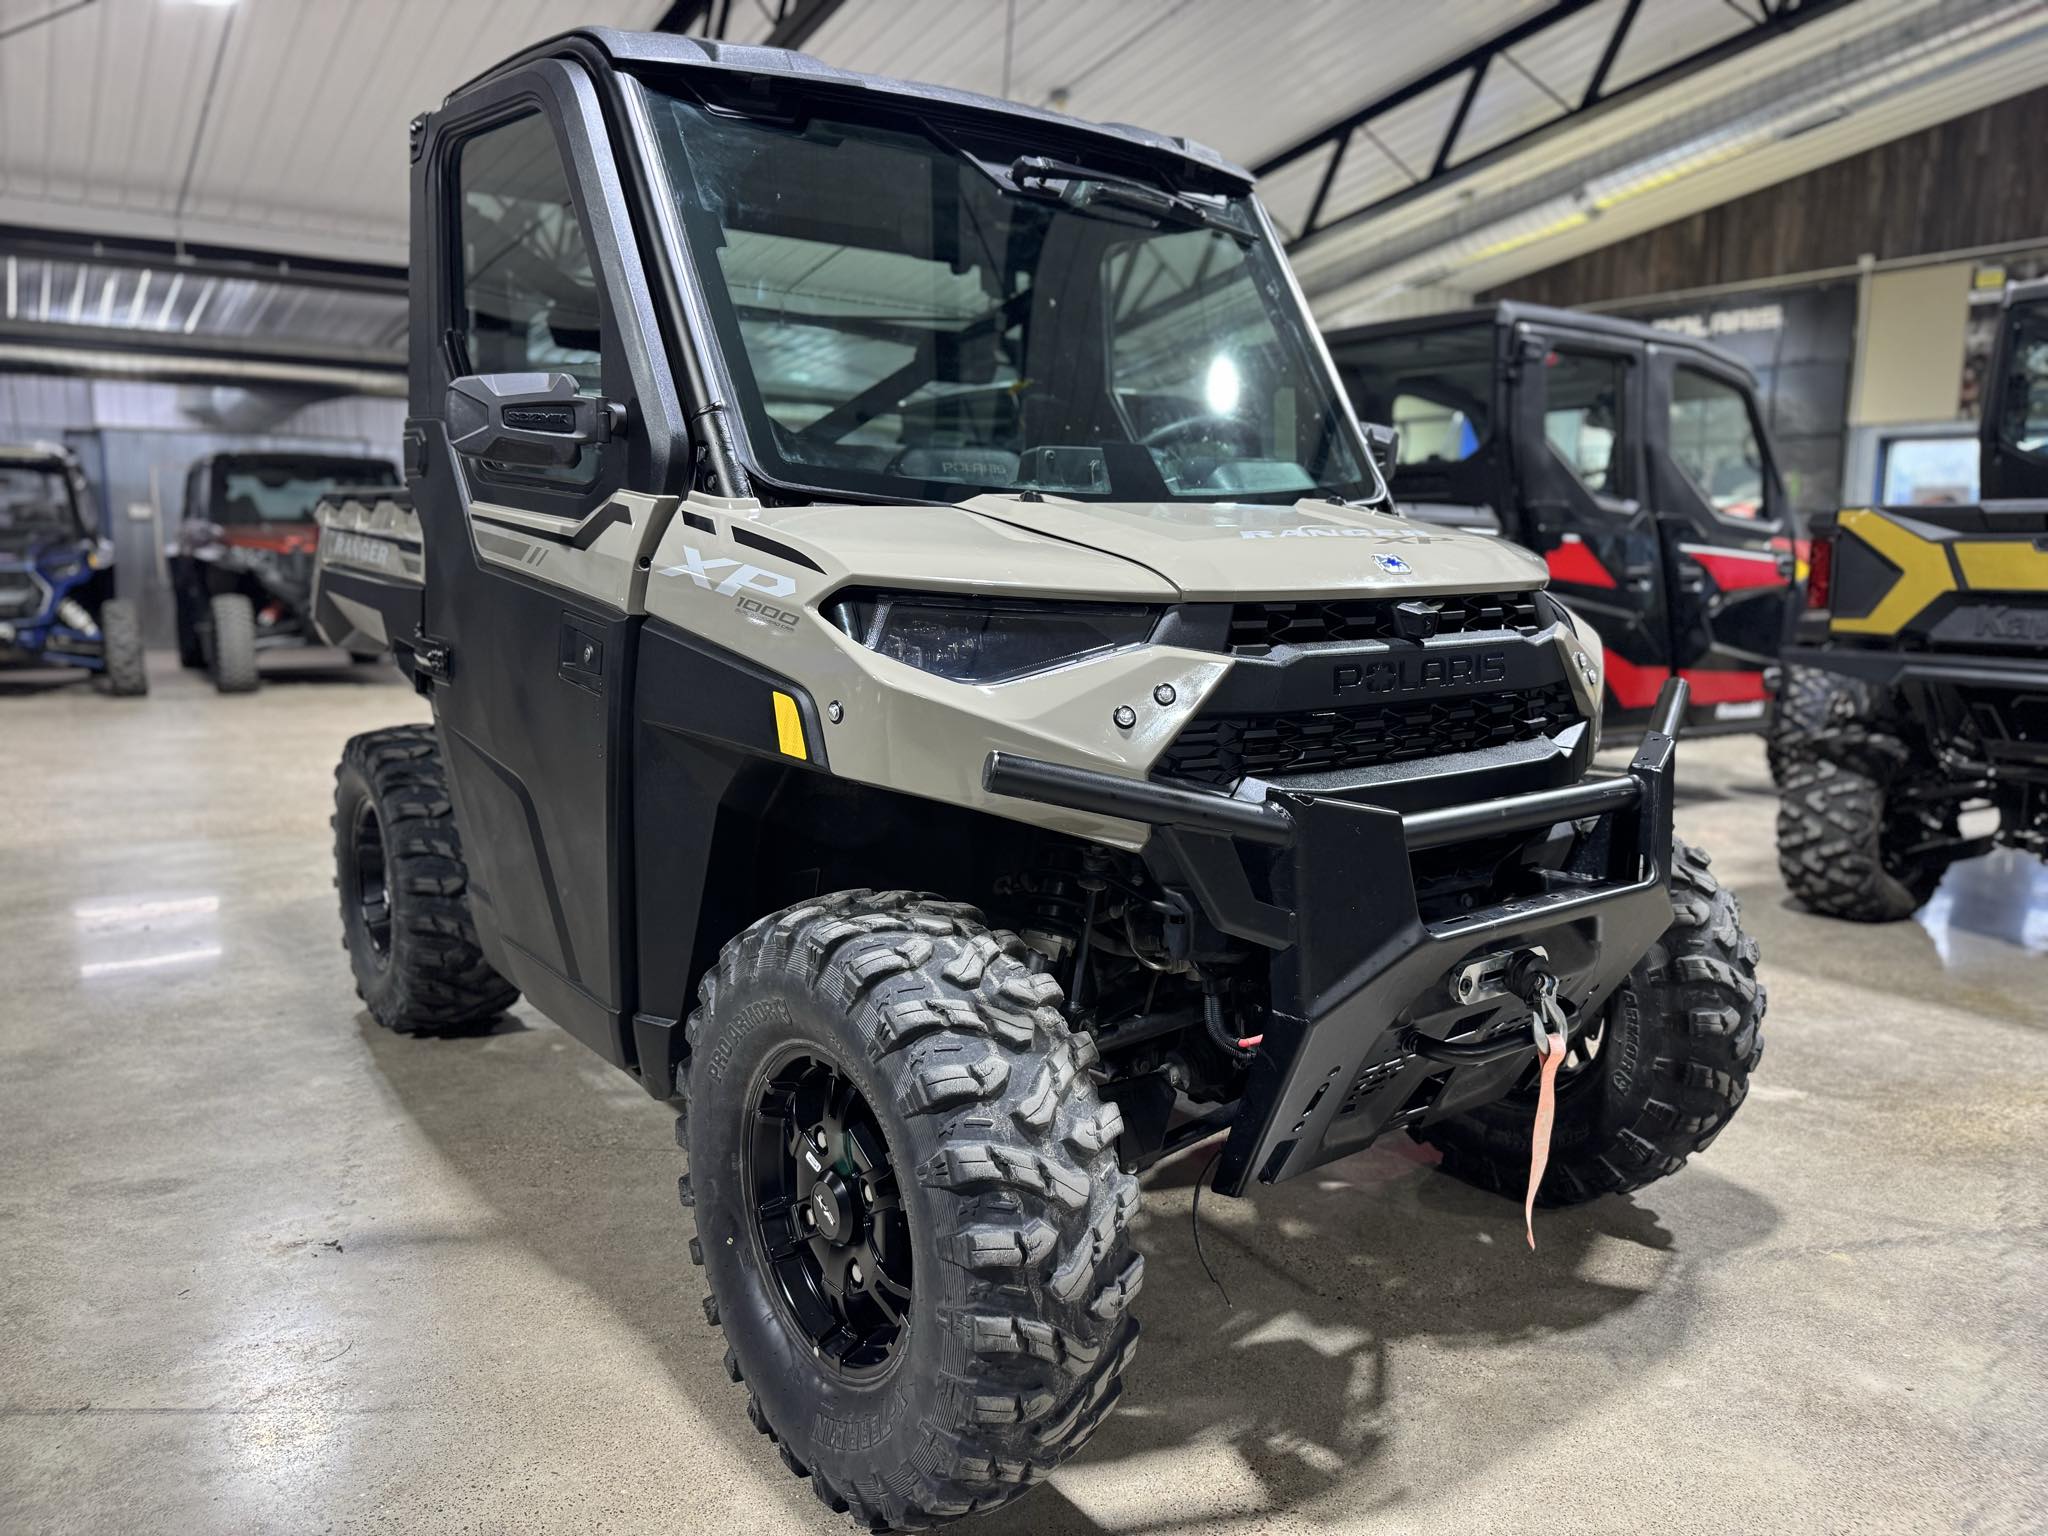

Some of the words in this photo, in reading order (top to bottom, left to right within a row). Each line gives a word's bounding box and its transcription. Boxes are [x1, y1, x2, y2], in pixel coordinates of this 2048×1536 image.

[333, 533, 389, 566] RANGER
[1239, 528, 1431, 540] RANGER
[656, 545, 796, 597] XP
[736, 596, 800, 626] 1000
[1333, 653, 1505, 697] POLARIS
[706, 1036, 733, 1085] PRO
[727, 1000, 779, 1047] ARMOR
